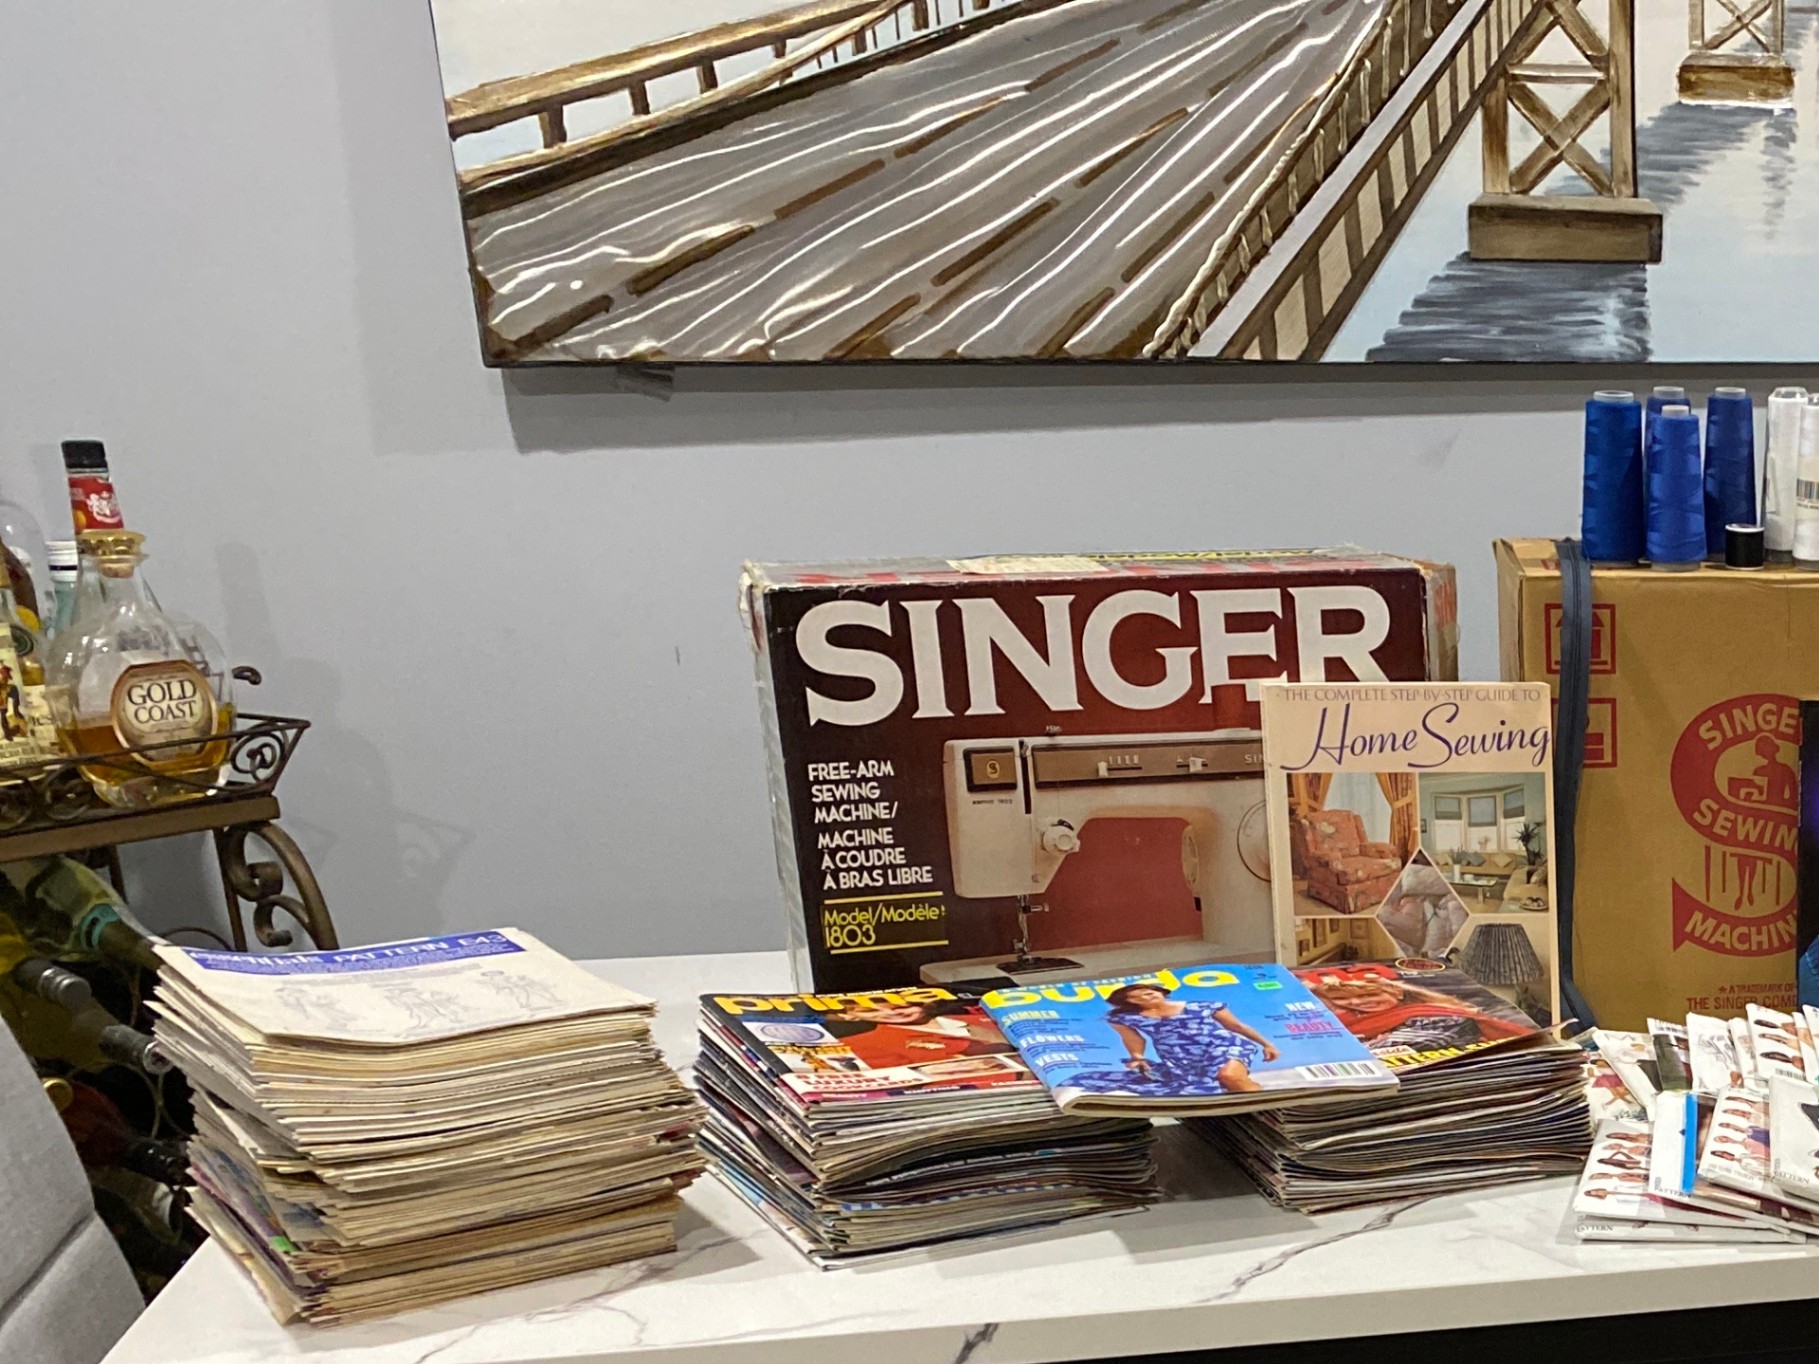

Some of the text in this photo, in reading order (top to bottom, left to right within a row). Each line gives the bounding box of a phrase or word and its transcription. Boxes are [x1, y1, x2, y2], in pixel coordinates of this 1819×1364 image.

[795, 585, 1395, 727] SINGER
[127, 679, 197, 705] GOLD
[1285, 688, 1541, 702] THE COMPLETE STEP-BY-STEP GUIDE TO
[134, 700, 196, 724] COAST
[1280, 702, 1550, 771] Home Sewing
[1698, 703, 1800, 751] SINGE
[808, 760, 894, 781] FREE-ARM
[811, 782, 880, 802] SEWING
[814, 801, 898, 823] MACHINE/
[1692, 798, 1798, 850] SEWIN
[818, 827, 894, 849] MACHINE
[821, 847, 906, 870] À COUDRE
[823, 866, 933, 890] À BRAS LIBRE
[825, 924, 876, 948] 1803
[1684, 910, 1797, 951] MACHIN
[333, 941, 449, 963] PATTERN
[713, 987, 958, 1014] prima
[1285, 1001, 1316, 1012] NEW
[1687, 998, 1709, 1010] THE
[1001, 1010, 1060, 1029] SUMMER
[1285, 1021, 1333, 1034] BEAUTY
[1020, 1035, 1084, 1048] FLOWERS
[1035, 1053, 1079, 1067] VESTS
[1576, 1223, 1614, 1233] PATTERN
